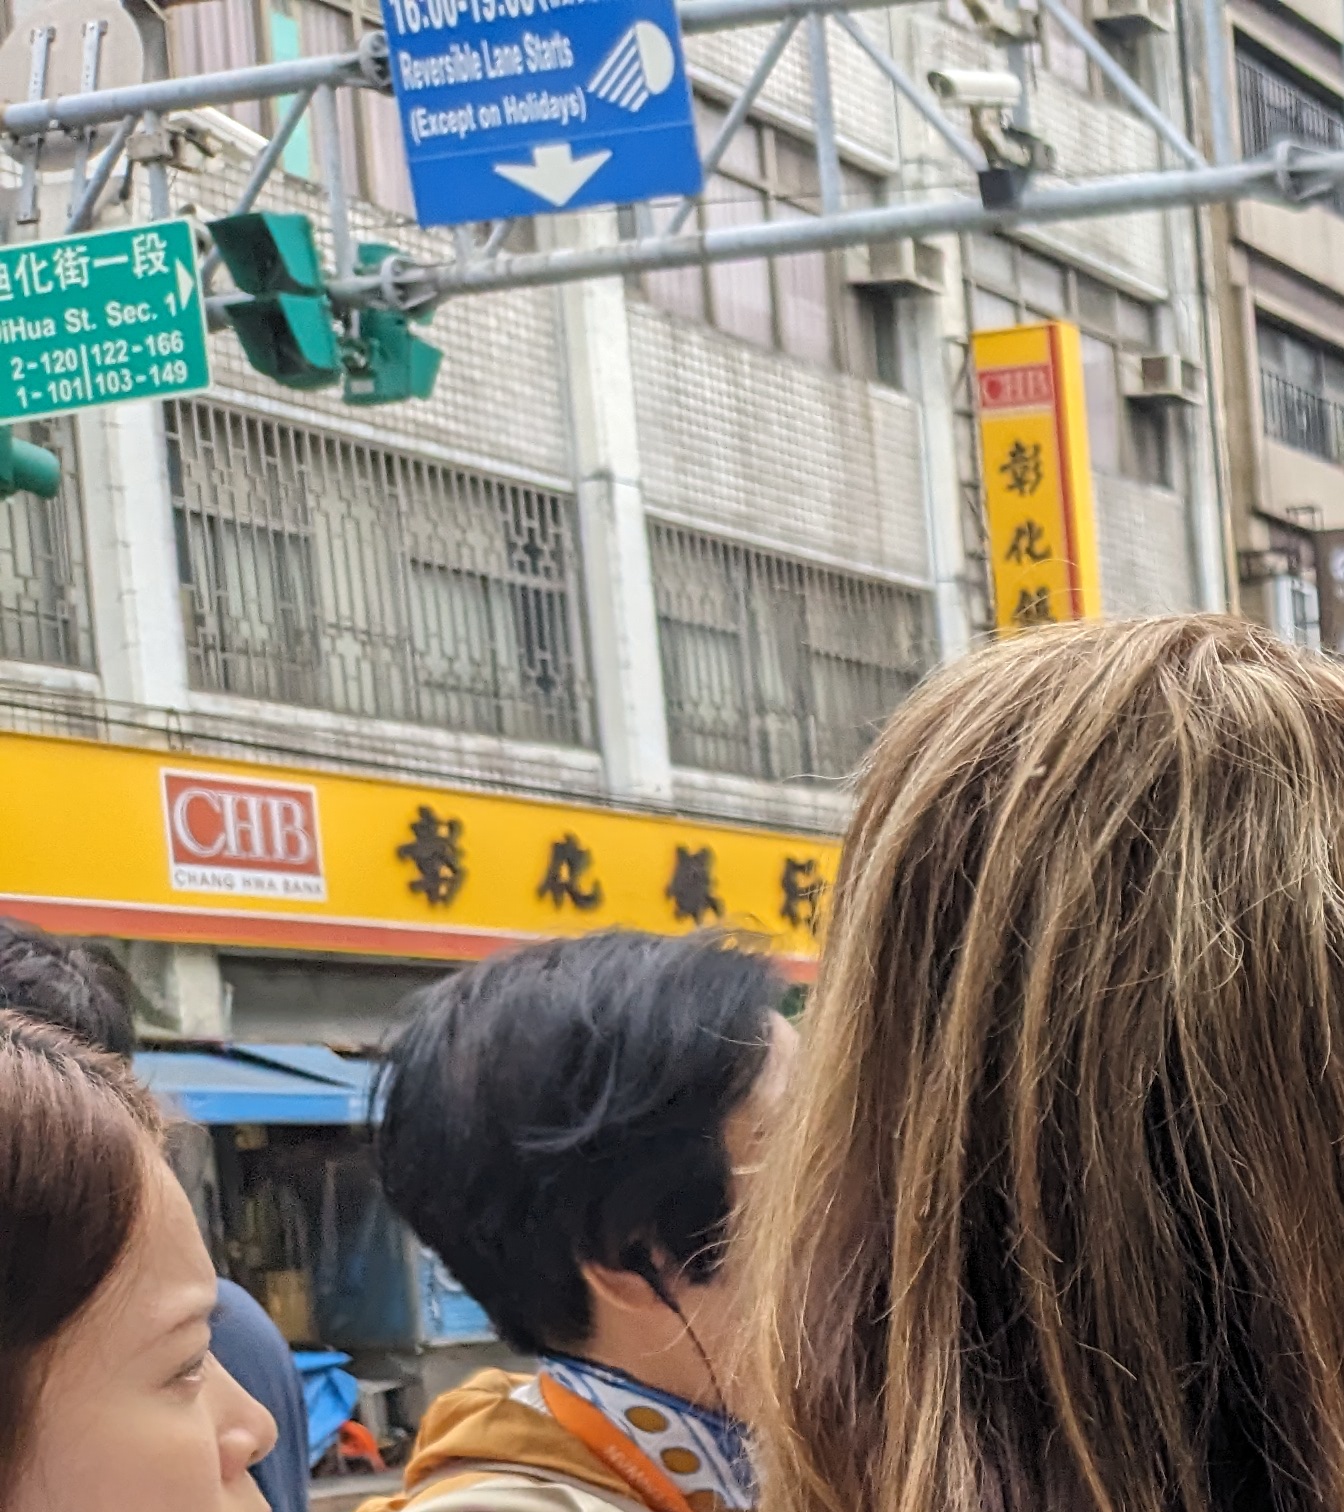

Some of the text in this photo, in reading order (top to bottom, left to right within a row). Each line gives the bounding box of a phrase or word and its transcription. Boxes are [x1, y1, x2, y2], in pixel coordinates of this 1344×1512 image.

[400, 30, 574, 90] Reversible Lane Starts
[410, 85, 588, 146] (Except on Holidays)
[0, 291, 177, 344] iHua St. Sec. 1
[10, 329, 185, 381] 2-120 122-166
[95, 359, 188, 396] 103-149
[173, 787, 311, 865] CHB
[174, 869, 235, 890] CHANG
[241, 876, 278, 892] HWA
